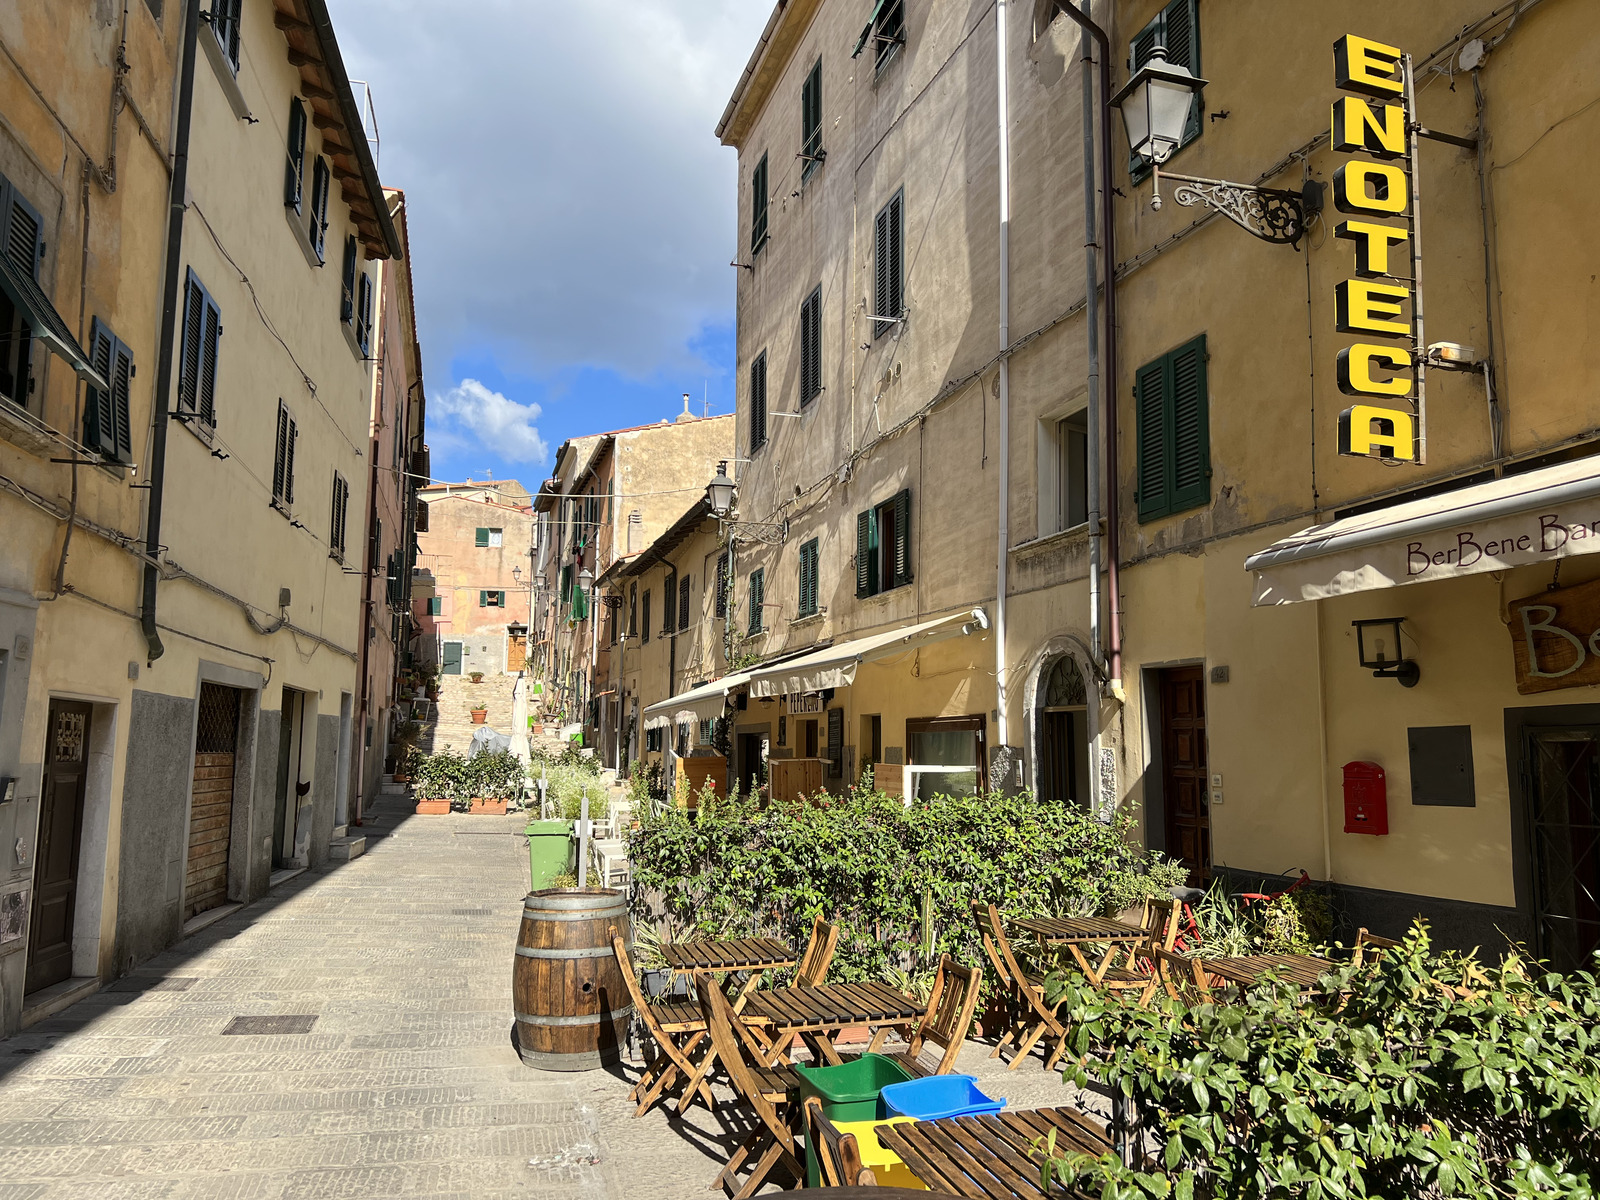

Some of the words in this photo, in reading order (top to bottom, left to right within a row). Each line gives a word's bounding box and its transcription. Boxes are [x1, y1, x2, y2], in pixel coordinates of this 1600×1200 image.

[1343, 33, 1414, 461] ENOTECA
[1407, 532, 1531, 576] BerBene
[1538, 514, 1600, 553] Bar
